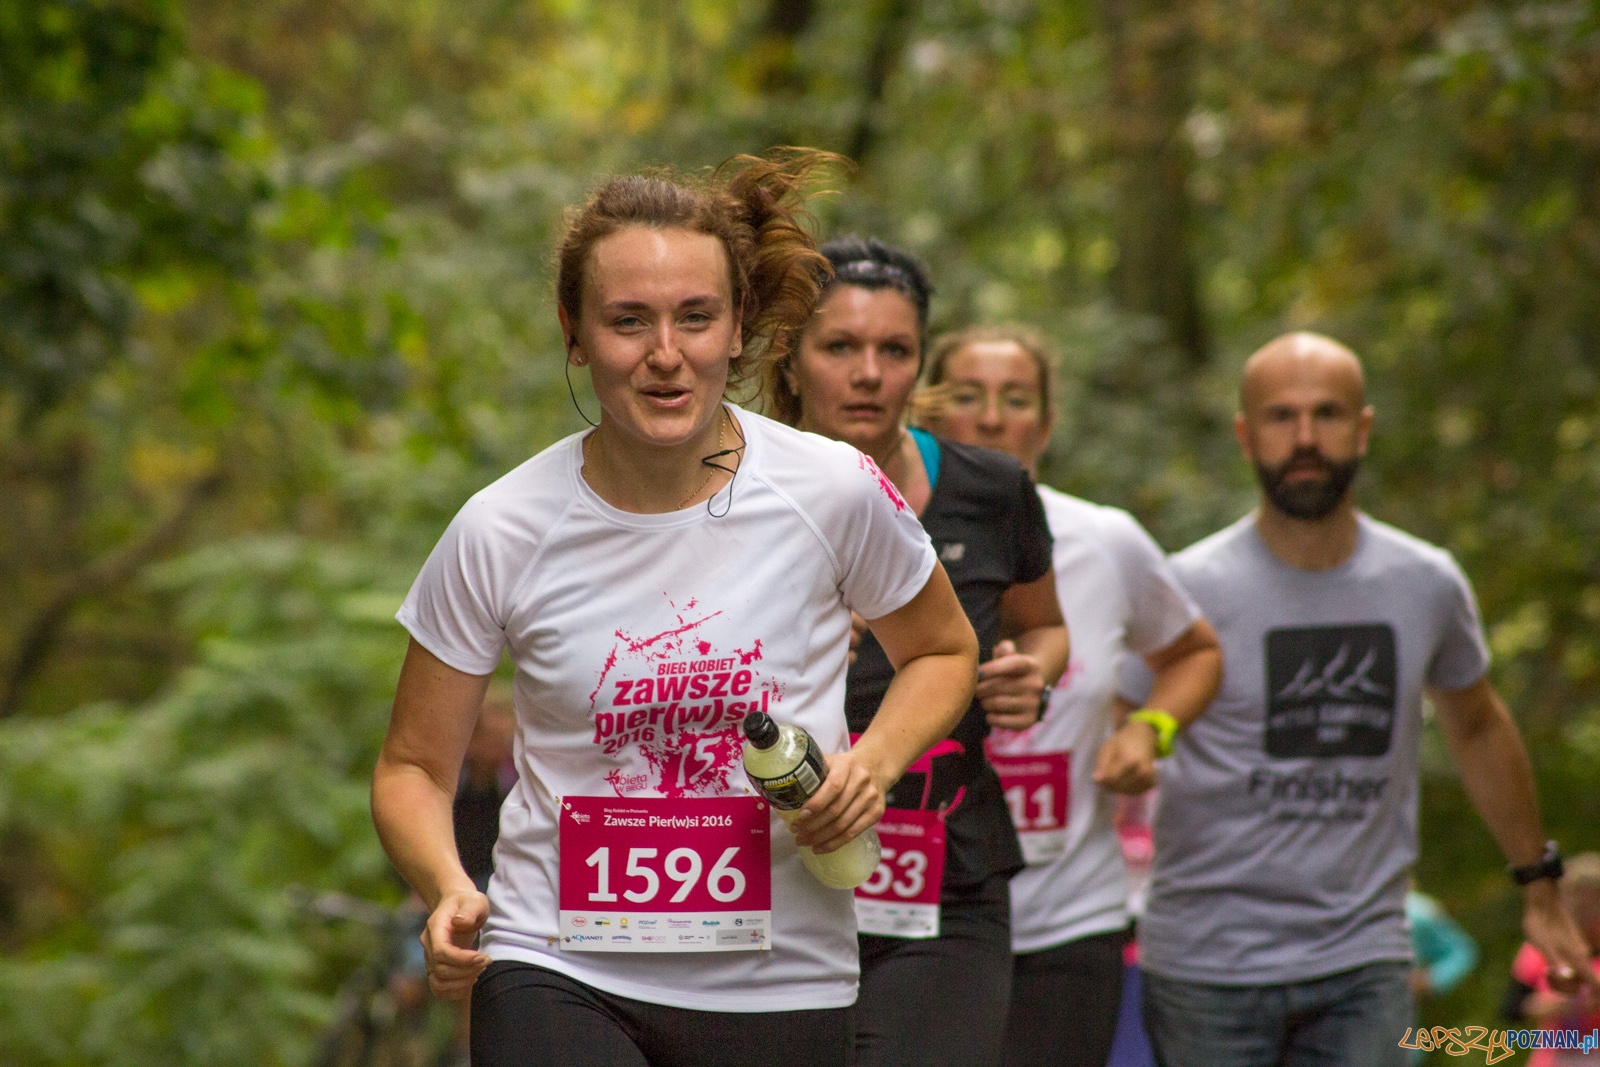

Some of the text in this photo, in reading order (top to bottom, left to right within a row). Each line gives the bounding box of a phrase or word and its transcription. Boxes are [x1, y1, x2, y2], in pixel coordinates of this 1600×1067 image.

[657, 657, 735, 676] BIEG KOBIET
[612, 669, 752, 706] zawsze
[603, 727, 655, 755] 2016
[603, 815, 646, 827] Zawsze
[649, 815, 699, 829] Pier(w)si
[701, 815, 733, 827] 2016
[585, 846, 746, 903] 1596
